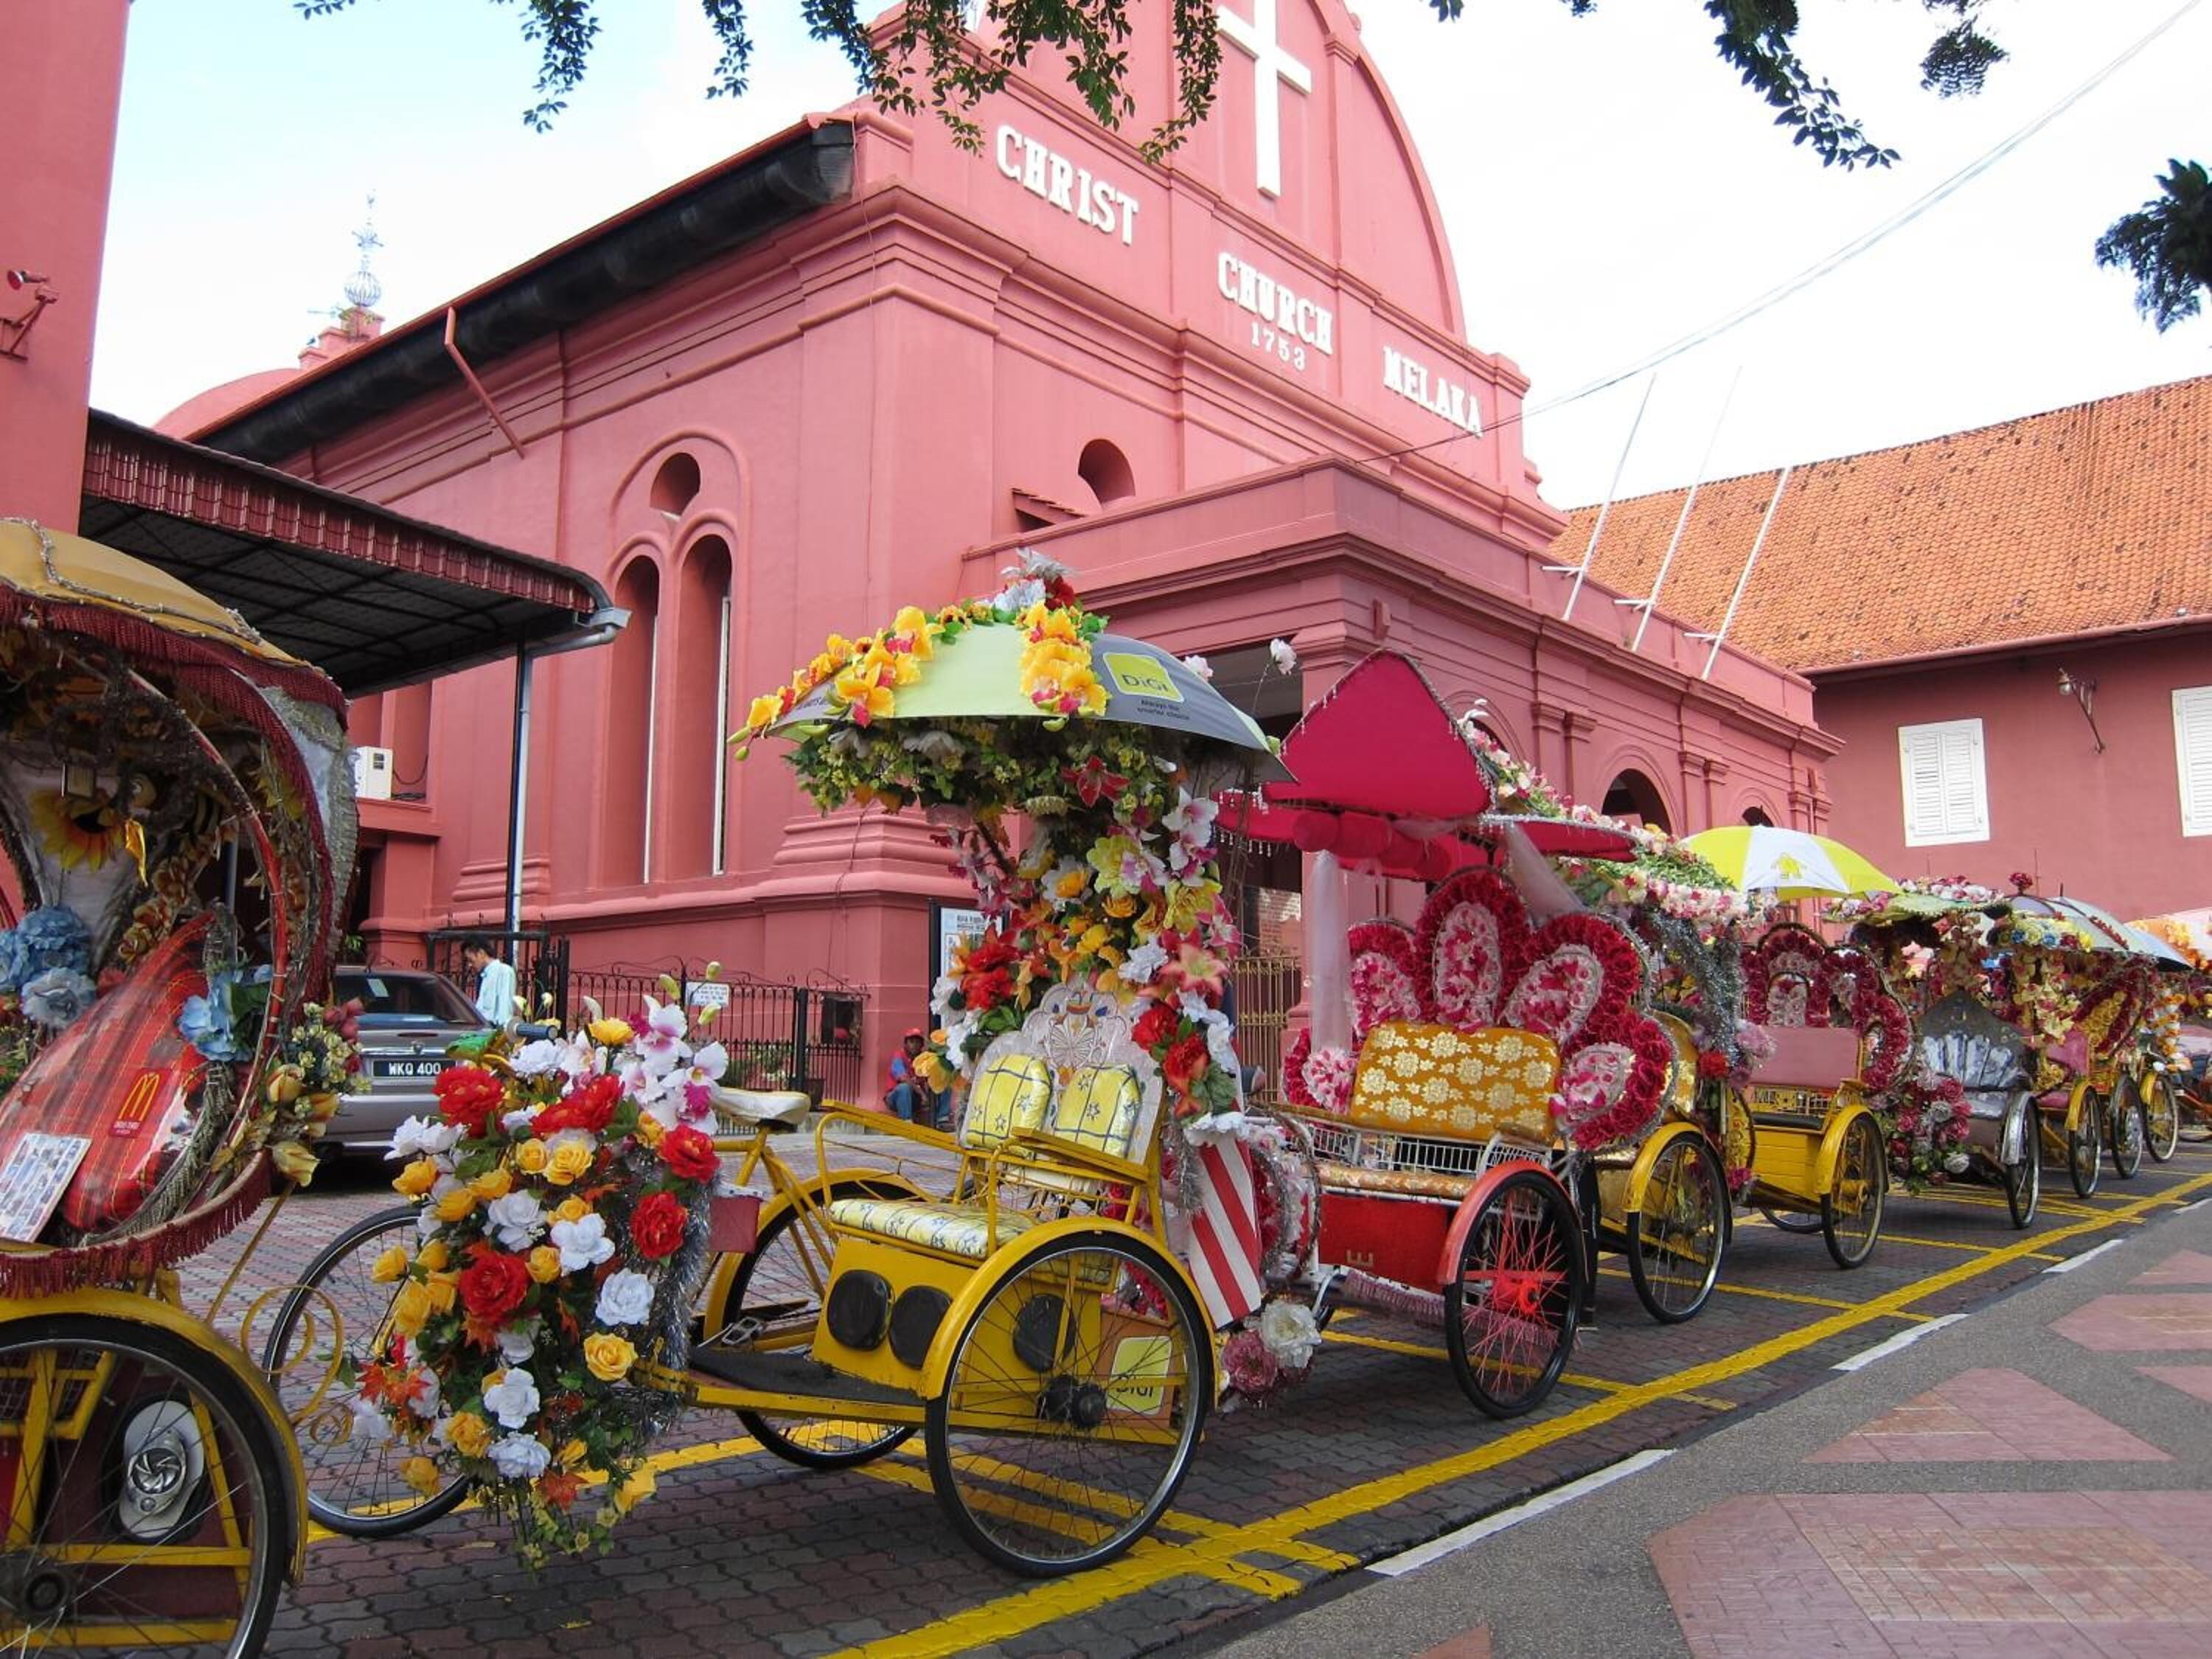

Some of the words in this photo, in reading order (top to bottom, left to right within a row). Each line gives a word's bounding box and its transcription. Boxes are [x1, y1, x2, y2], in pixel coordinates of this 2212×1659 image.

[997, 124, 1139, 246] CHRIST
[1218, 251, 1333, 357] CHURCH
[1382, 345, 1484, 439] MELAKA
[1251, 321, 1307, 371] 1753
[417, 1062, 442, 1074] 400
